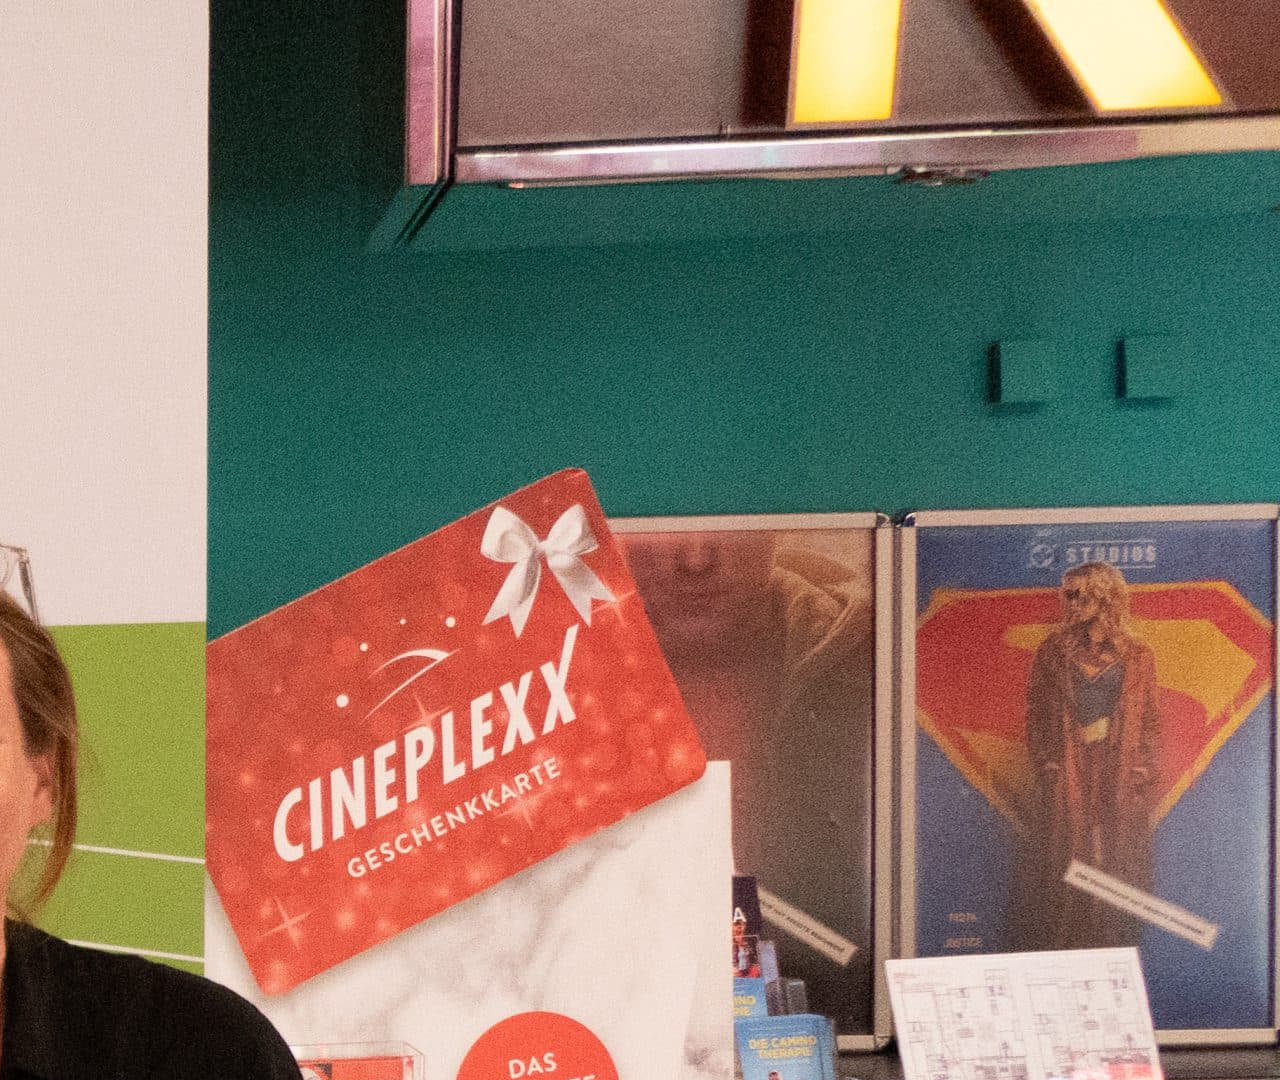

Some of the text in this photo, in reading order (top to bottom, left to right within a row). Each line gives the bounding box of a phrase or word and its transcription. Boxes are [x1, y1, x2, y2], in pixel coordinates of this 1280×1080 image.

[272, 623, 579, 862] CINEPLEXX
[346, 757, 561, 878] GESCHENKKARTE
[508, 1052, 557, 1079] DAS
